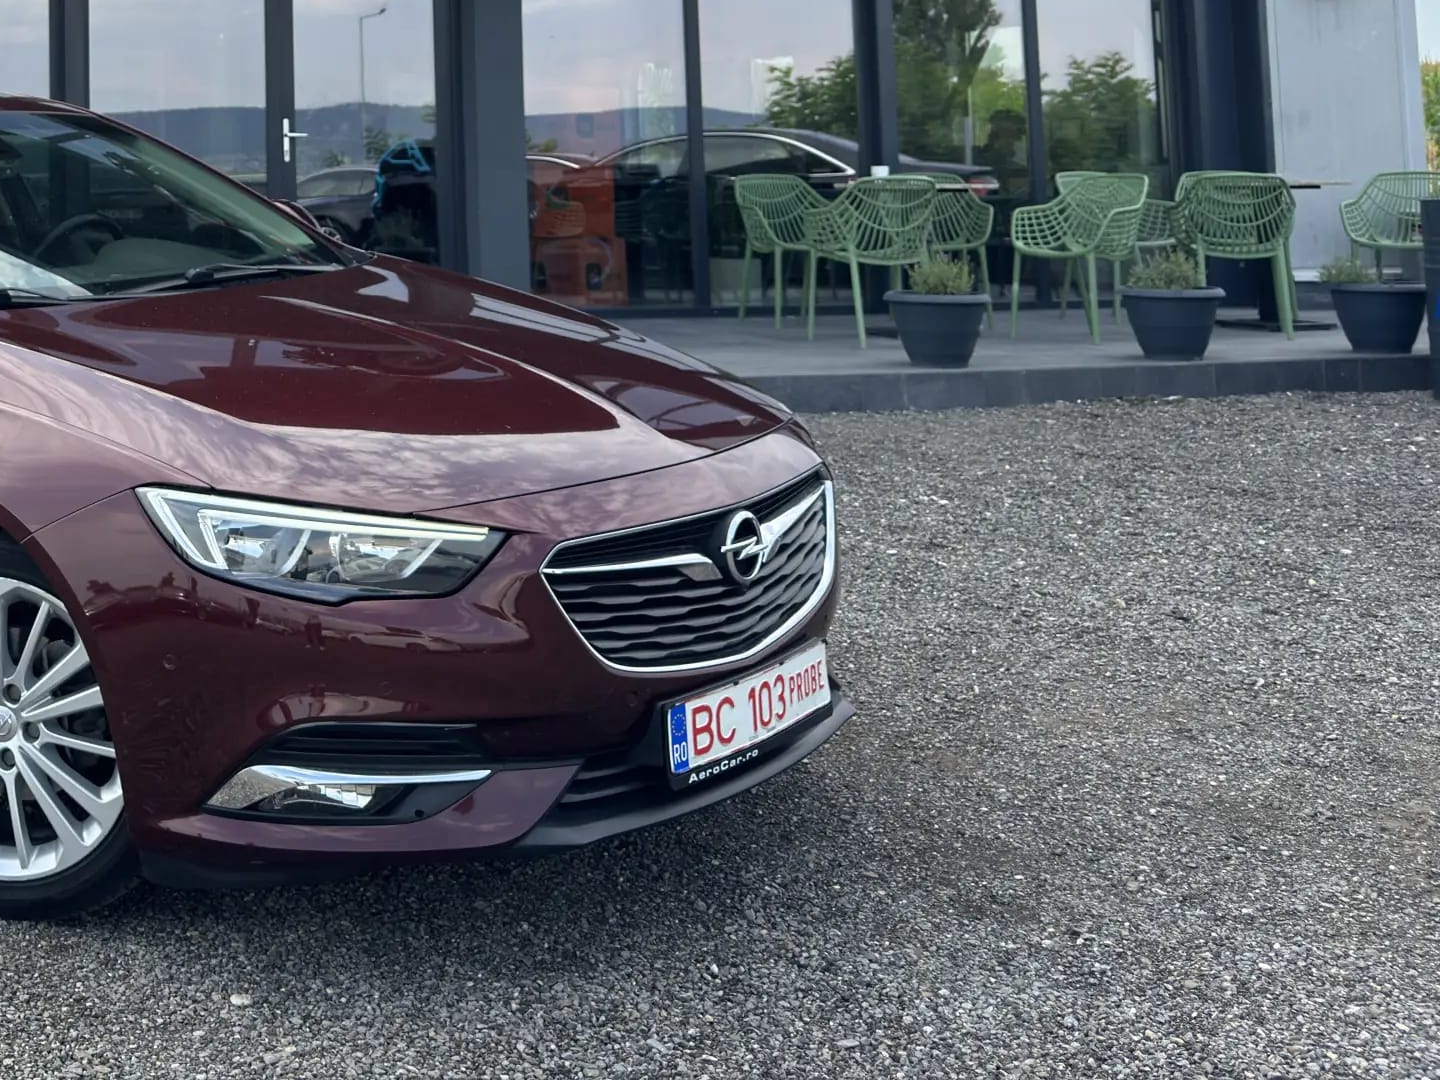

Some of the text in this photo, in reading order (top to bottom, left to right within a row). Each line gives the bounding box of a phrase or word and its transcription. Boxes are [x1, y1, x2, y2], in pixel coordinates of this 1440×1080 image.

[691, 659, 824, 756] BC 103 PROBE
[673, 741, 688, 765] RO
[688, 749, 759, 784] AeroCar.ro
